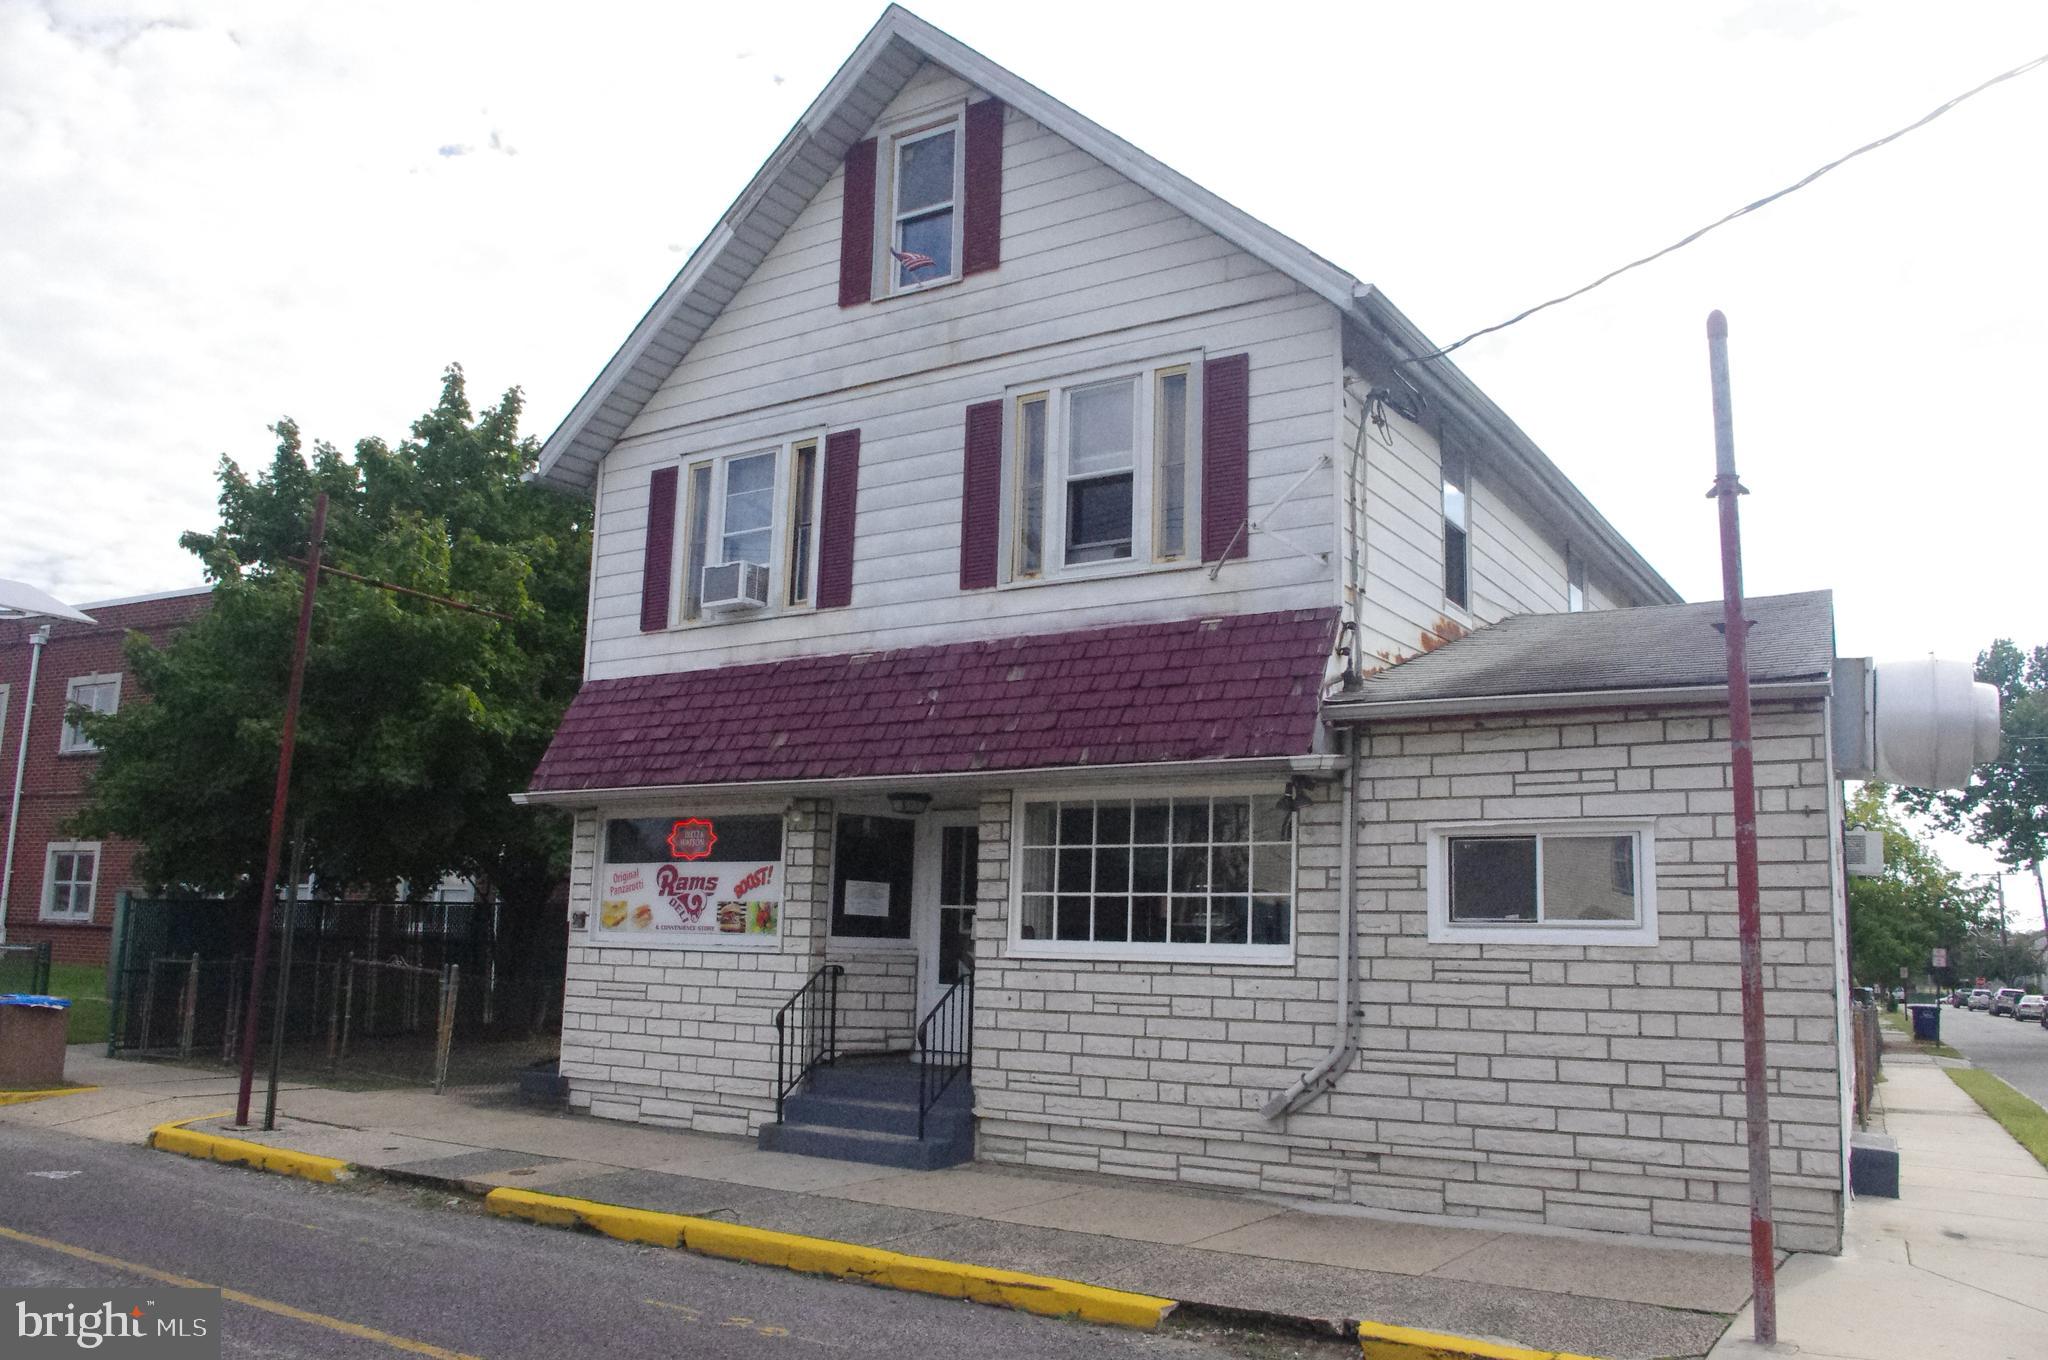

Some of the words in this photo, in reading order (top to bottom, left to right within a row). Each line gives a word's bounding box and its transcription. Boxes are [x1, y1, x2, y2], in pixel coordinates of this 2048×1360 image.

[613, 867, 640, 884] Original
[656, 864, 720, 897] Rams
[609, 878, 644, 896] Panzarotti
[668, 897, 689, 923] DELI
